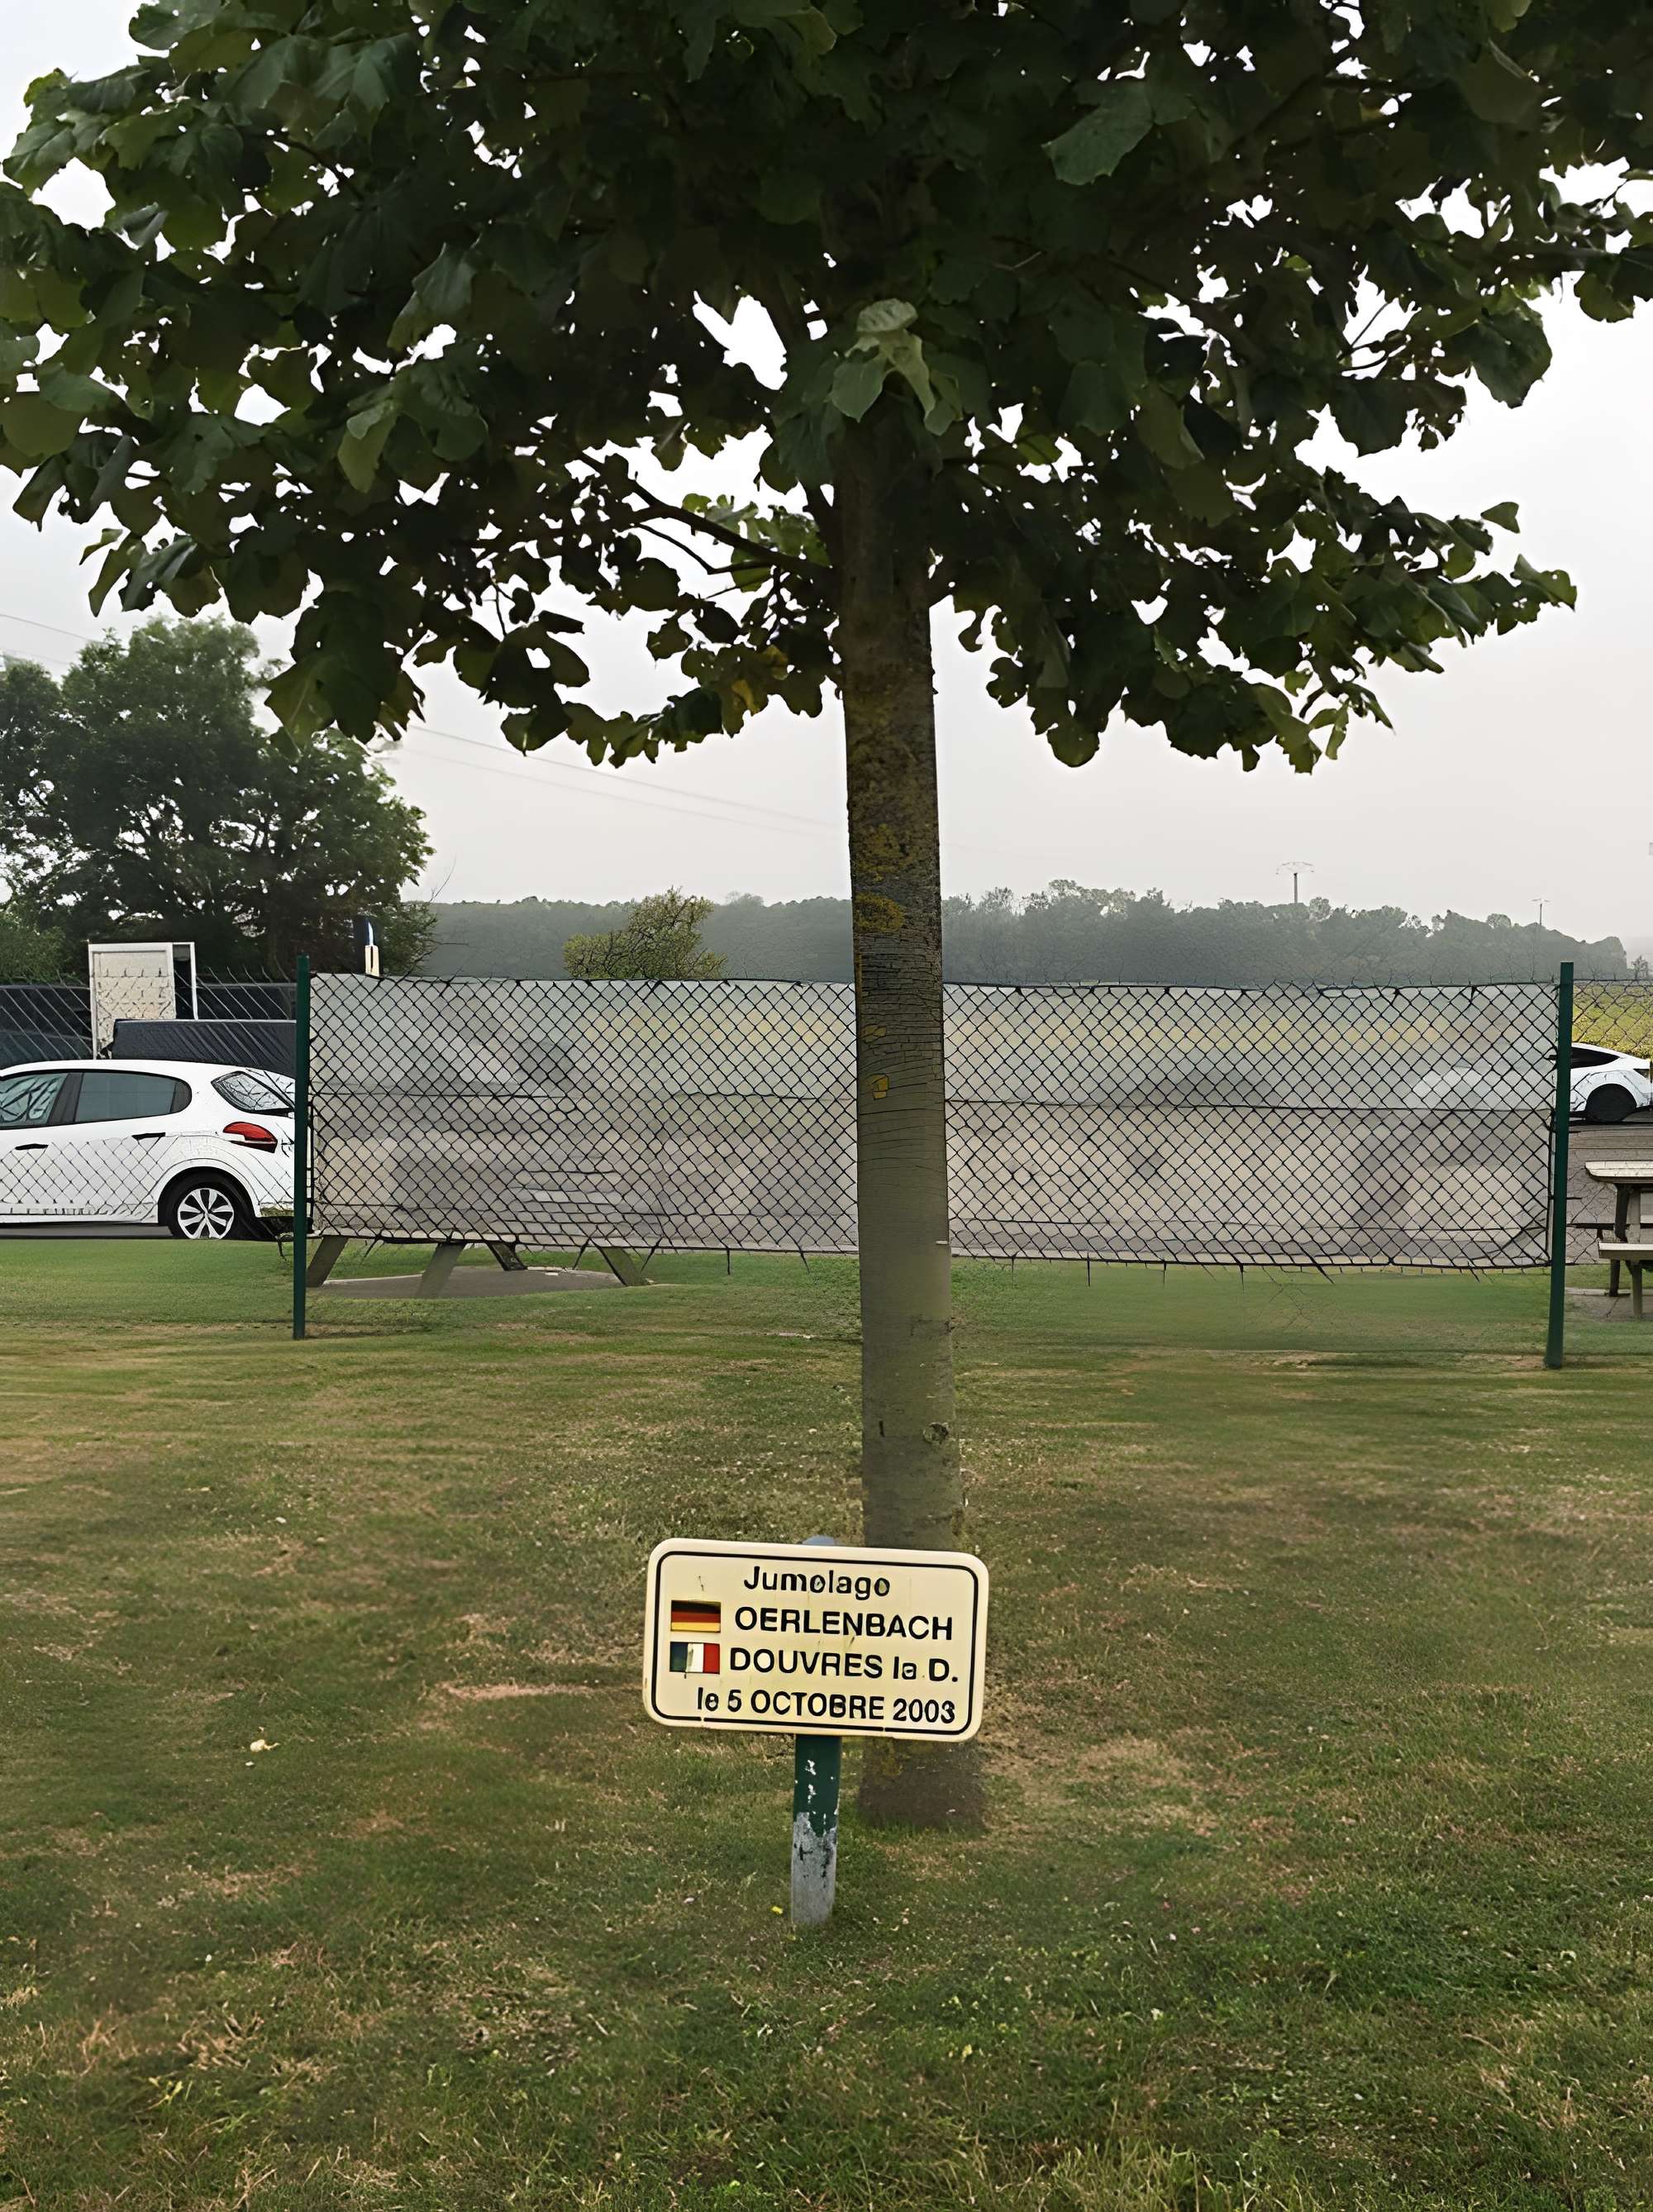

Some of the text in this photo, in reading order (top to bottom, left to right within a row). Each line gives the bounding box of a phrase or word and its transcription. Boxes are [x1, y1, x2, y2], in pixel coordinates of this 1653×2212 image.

[734, 1606, 953, 1641] OERLENBACH
[729, 1646, 959, 1683] DOUVRES la D.
[697, 1686, 955, 1724] le 5 OCTOBRE 2003
